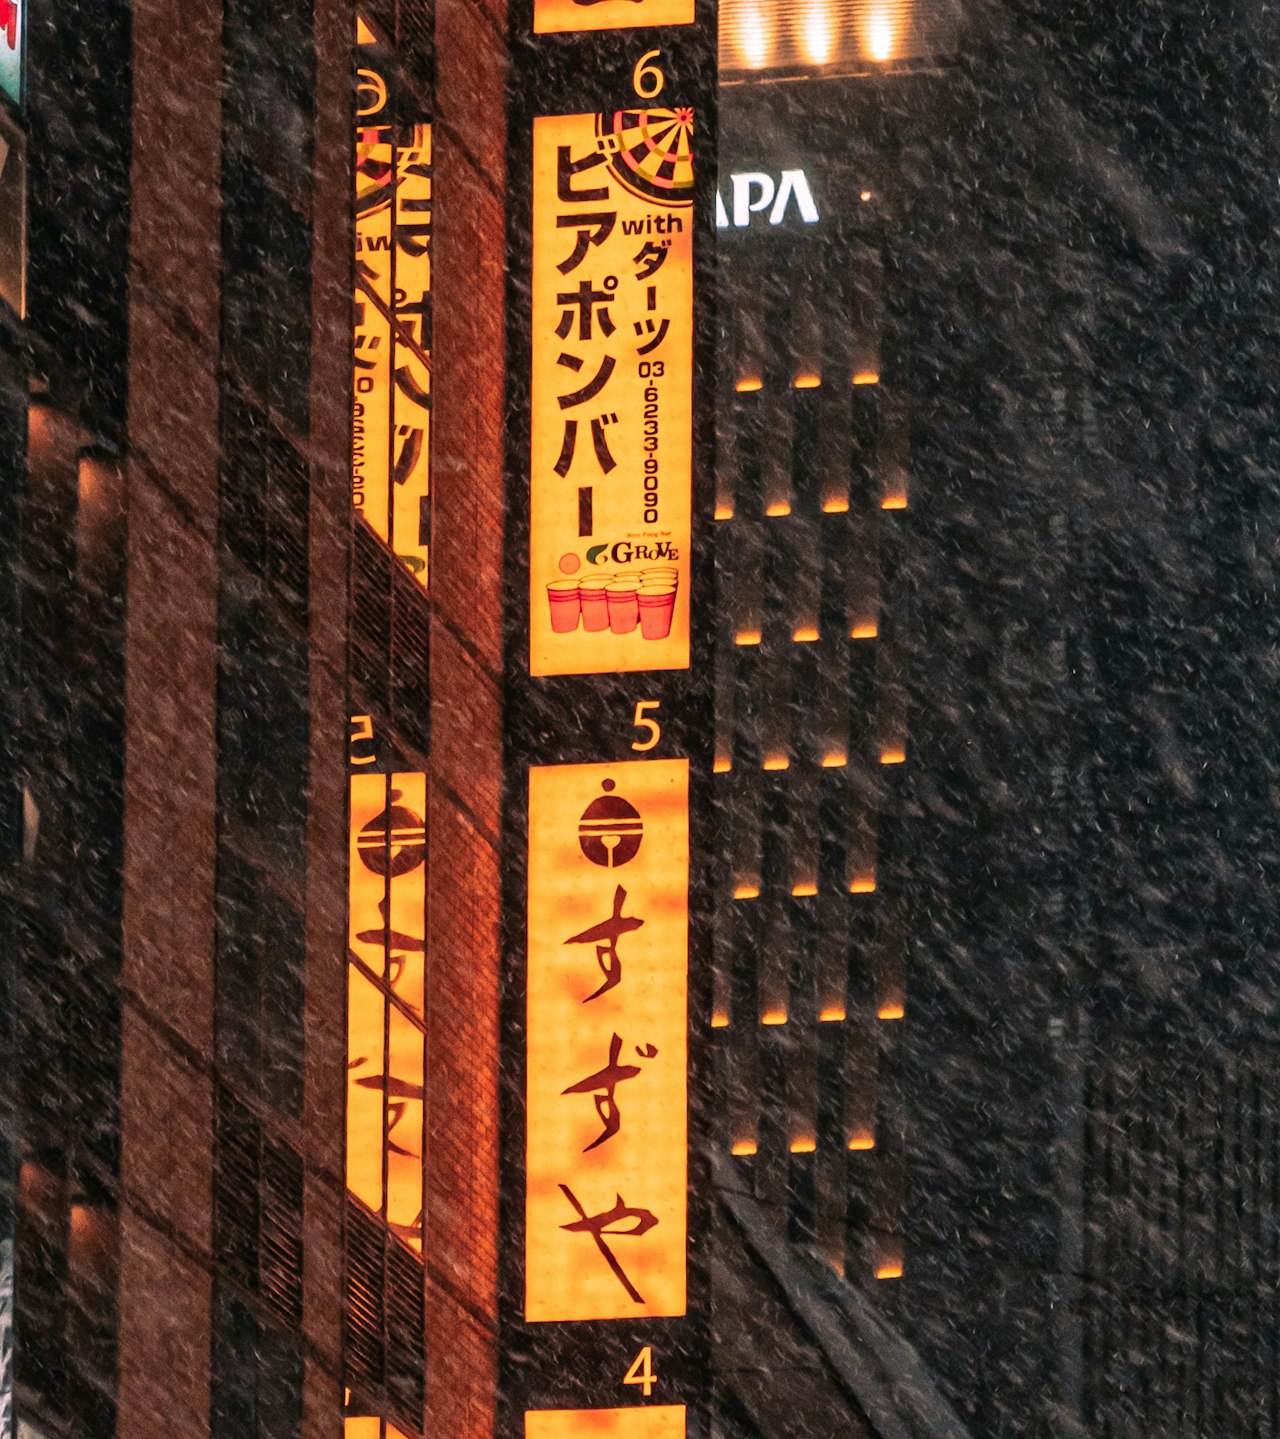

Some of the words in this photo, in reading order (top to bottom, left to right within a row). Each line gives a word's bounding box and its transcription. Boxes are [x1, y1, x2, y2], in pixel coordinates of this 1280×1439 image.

[633, 50, 665, 99] 6
[621, 213, 683, 236] with
[633, 240, 673, 356] ダーツ
[552, 139, 618, 538] ビアポンバー
[637, 360, 666, 524] 03-6233-9090
[611, 541, 679, 564] GROVE
[631, 701, 661, 751] 5
[558, 884, 659, 1304] すずや
[623, 1346, 658, 1396] 4
